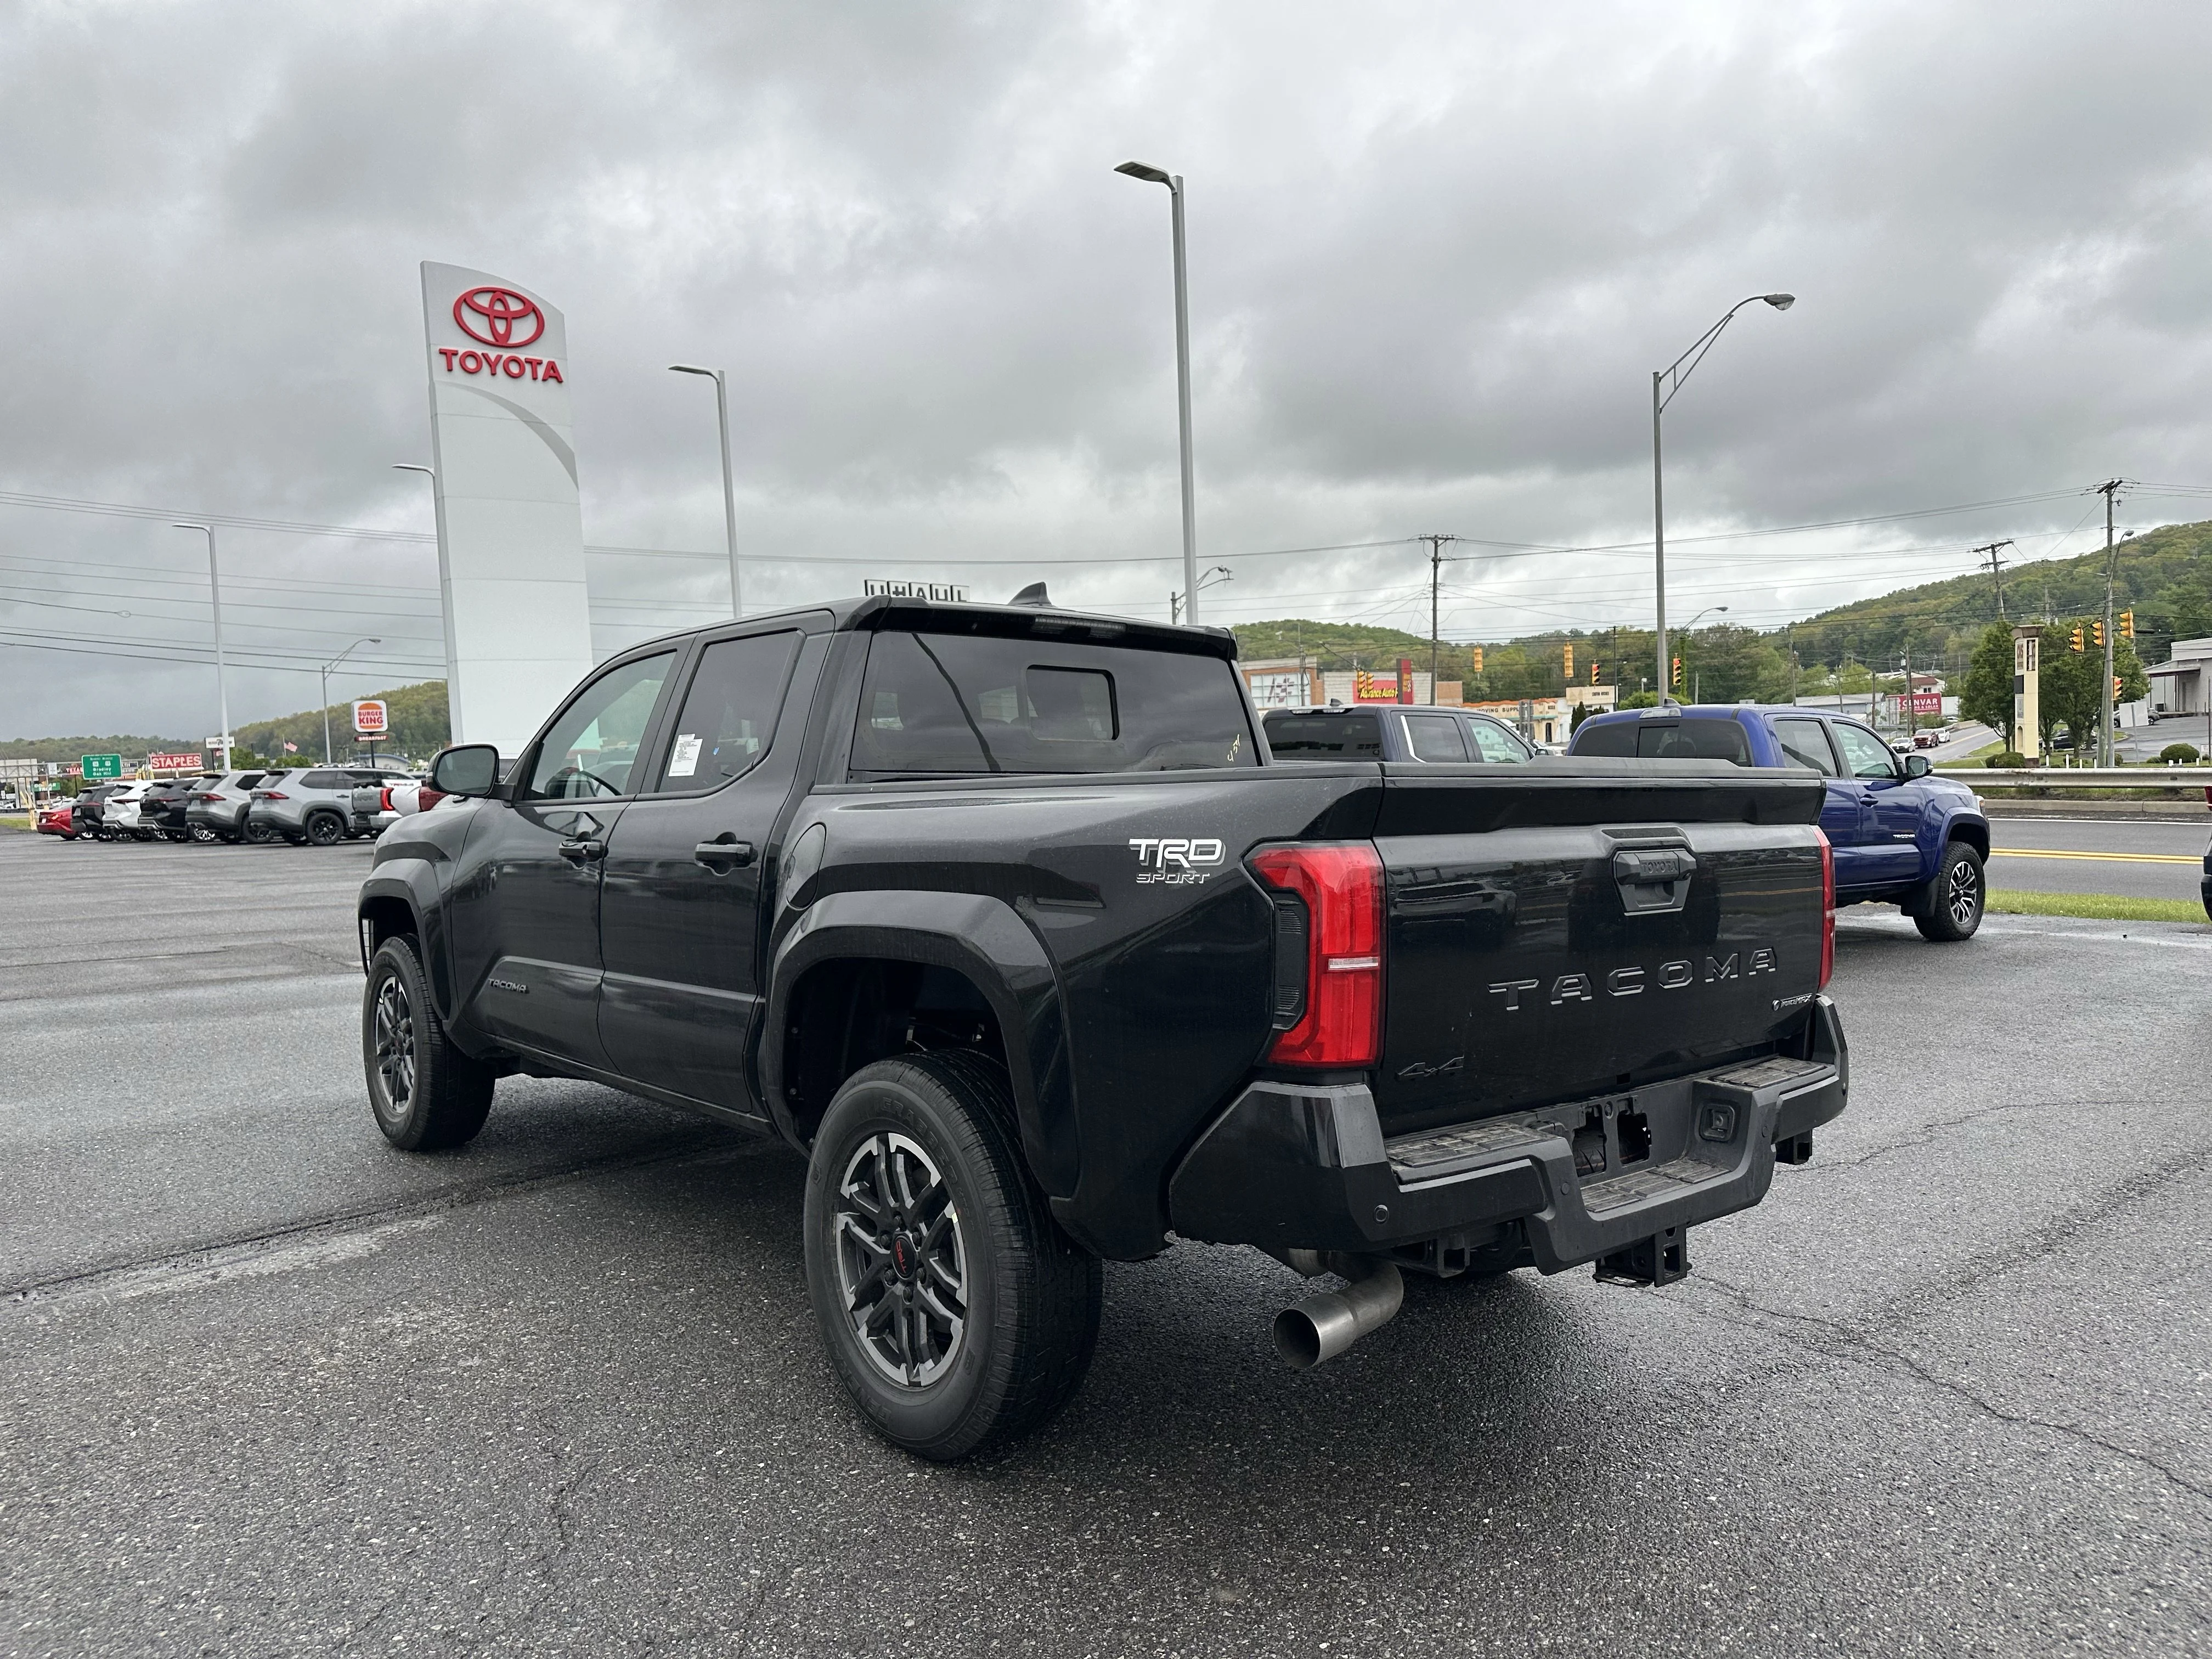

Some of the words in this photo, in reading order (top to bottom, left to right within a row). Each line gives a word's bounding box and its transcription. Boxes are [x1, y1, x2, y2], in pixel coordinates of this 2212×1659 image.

[439, 348, 563, 383] TOYOTA
[1382, 687, 1395, 698] Auto
[152, 755, 201, 768] STAPLES
[1128, 838, 1226, 873] TRD
[1641, 860, 1678, 874] TOYOTA
[1136, 872, 1210, 884] SPORT
[489, 978, 527, 992] TACOMA
[1487, 947, 1777, 1011] TACOMA
[880, 1096, 958, 1185] GRABBER
